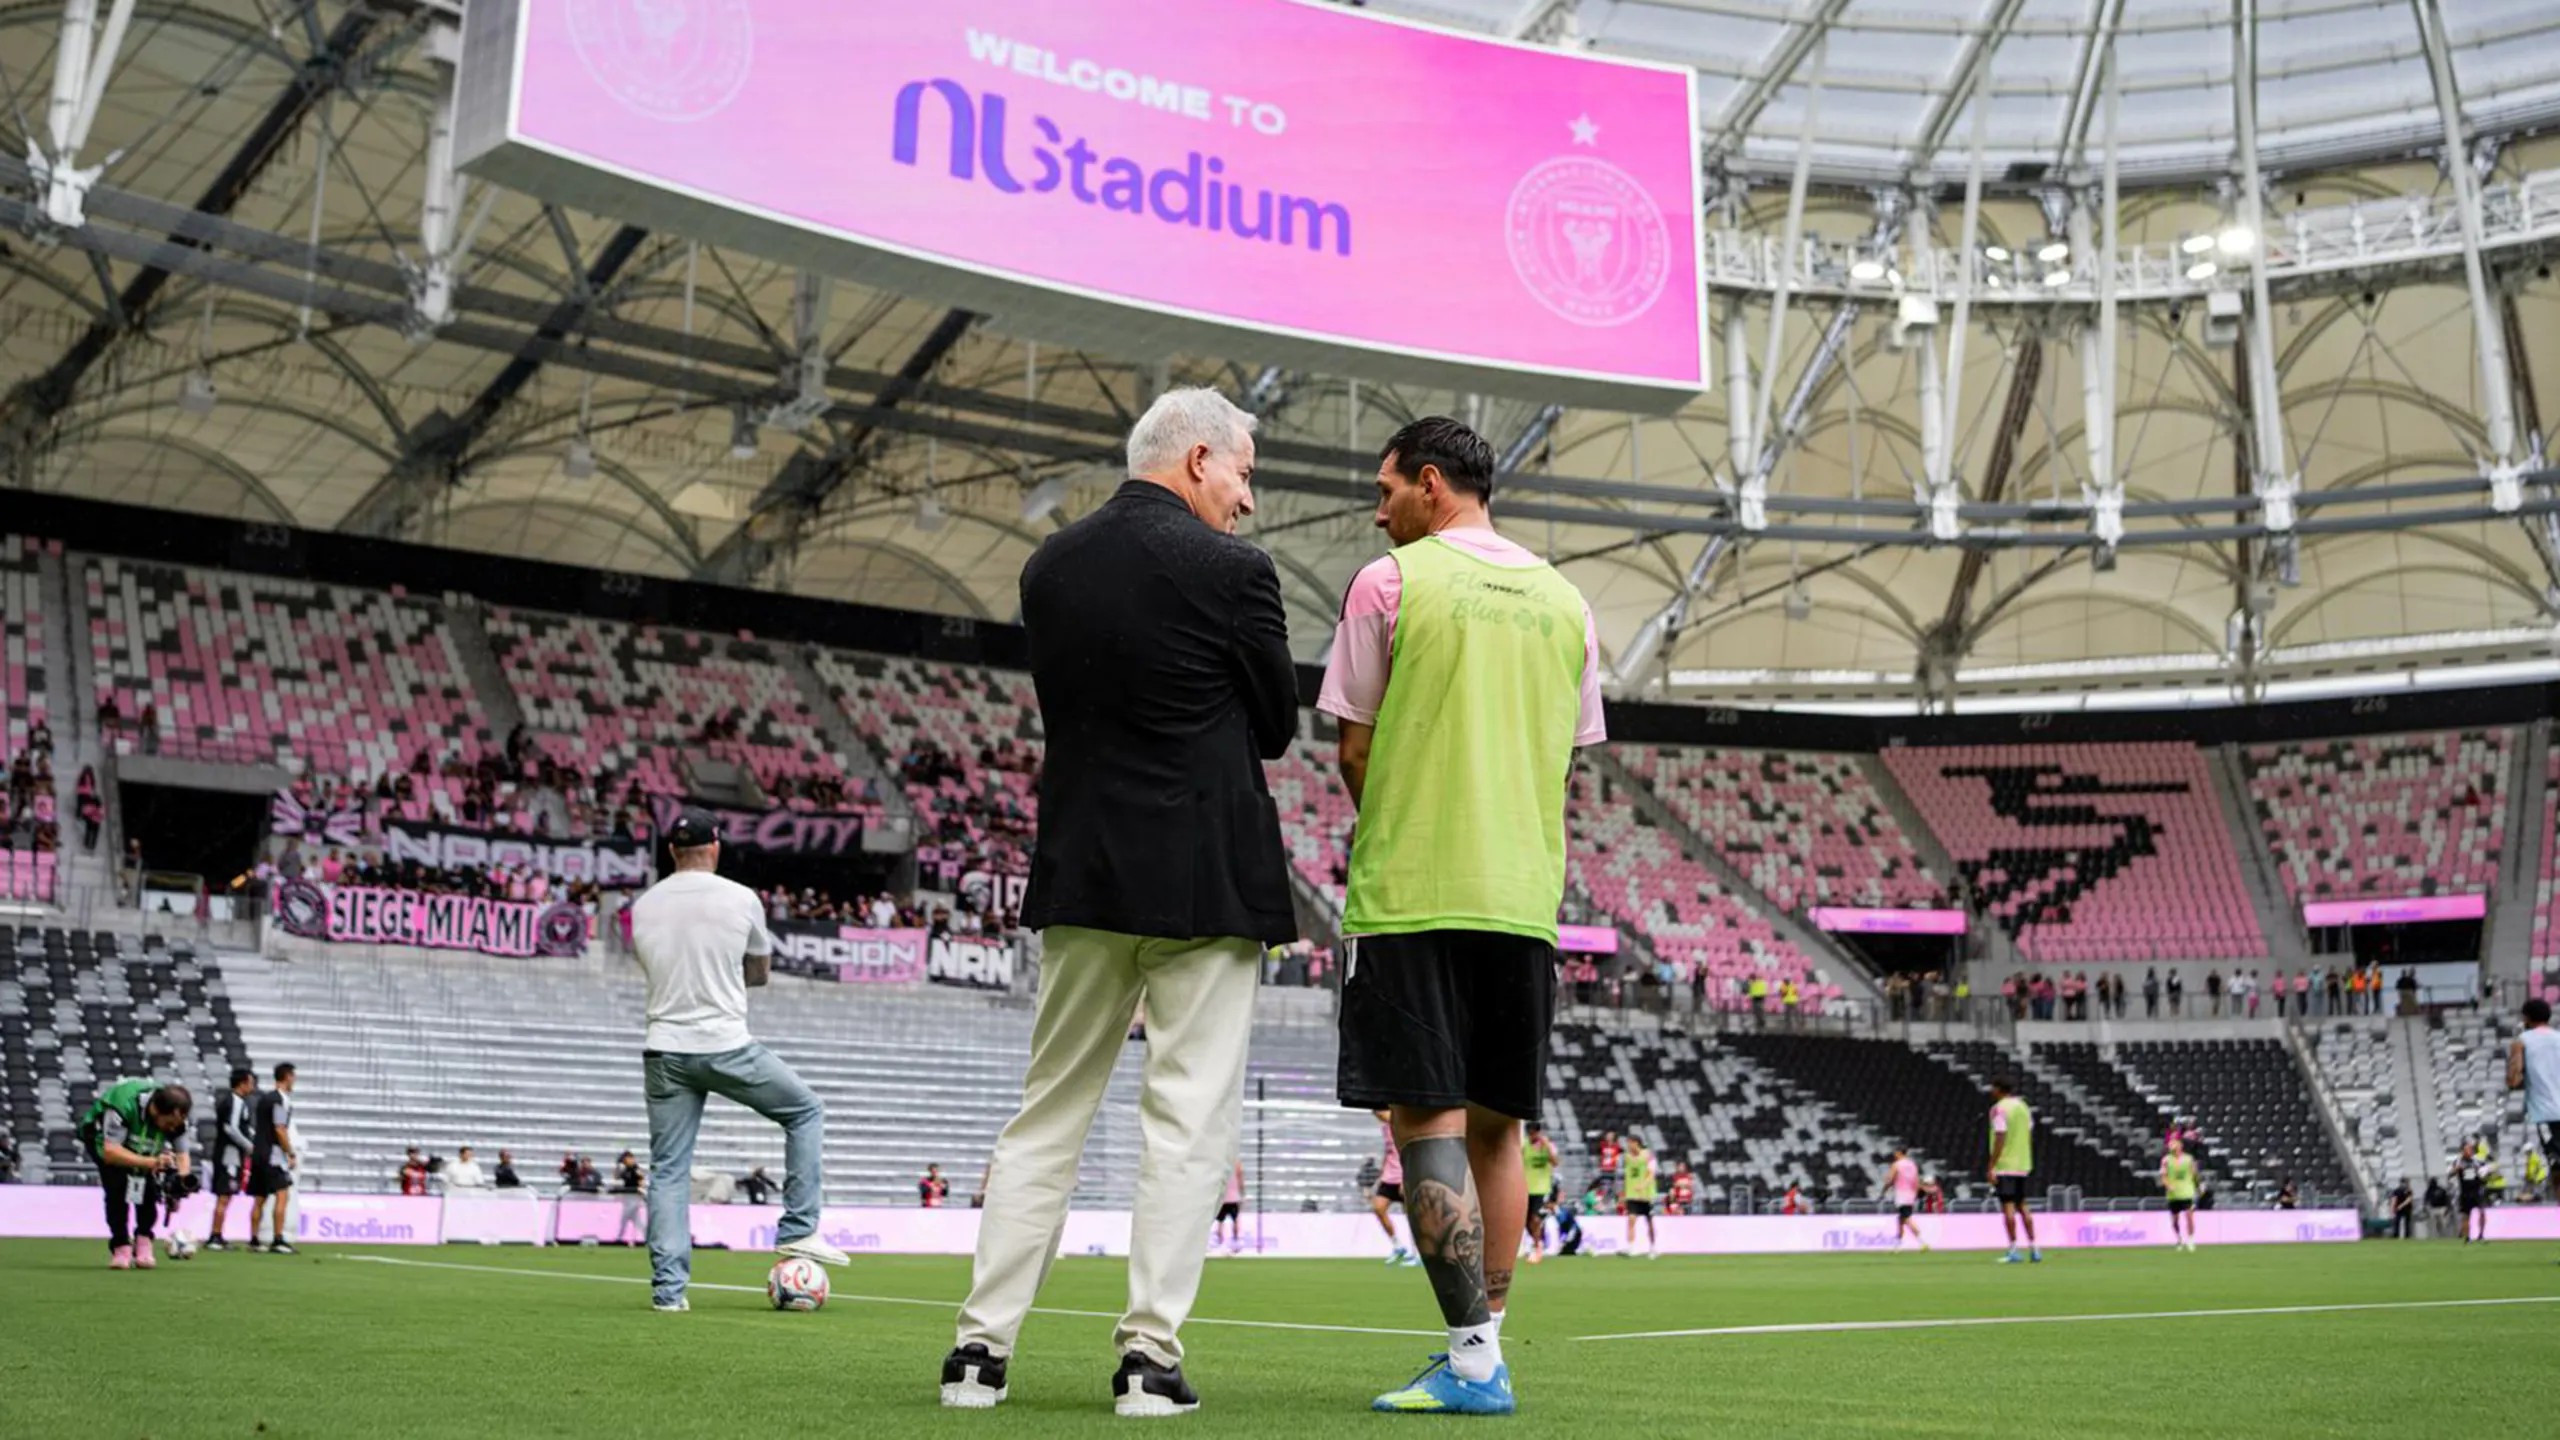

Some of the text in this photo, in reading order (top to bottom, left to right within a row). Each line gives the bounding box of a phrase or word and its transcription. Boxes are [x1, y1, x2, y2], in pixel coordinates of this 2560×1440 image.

[965, 26, 1287, 135] WELCOME TO
[755, 808, 860, 855] CITY
[332, 890, 534, 952] SIEGE MIAMI
[931, 939, 1014, 985] NRN
[316, 1215, 414, 1239] Stadium
